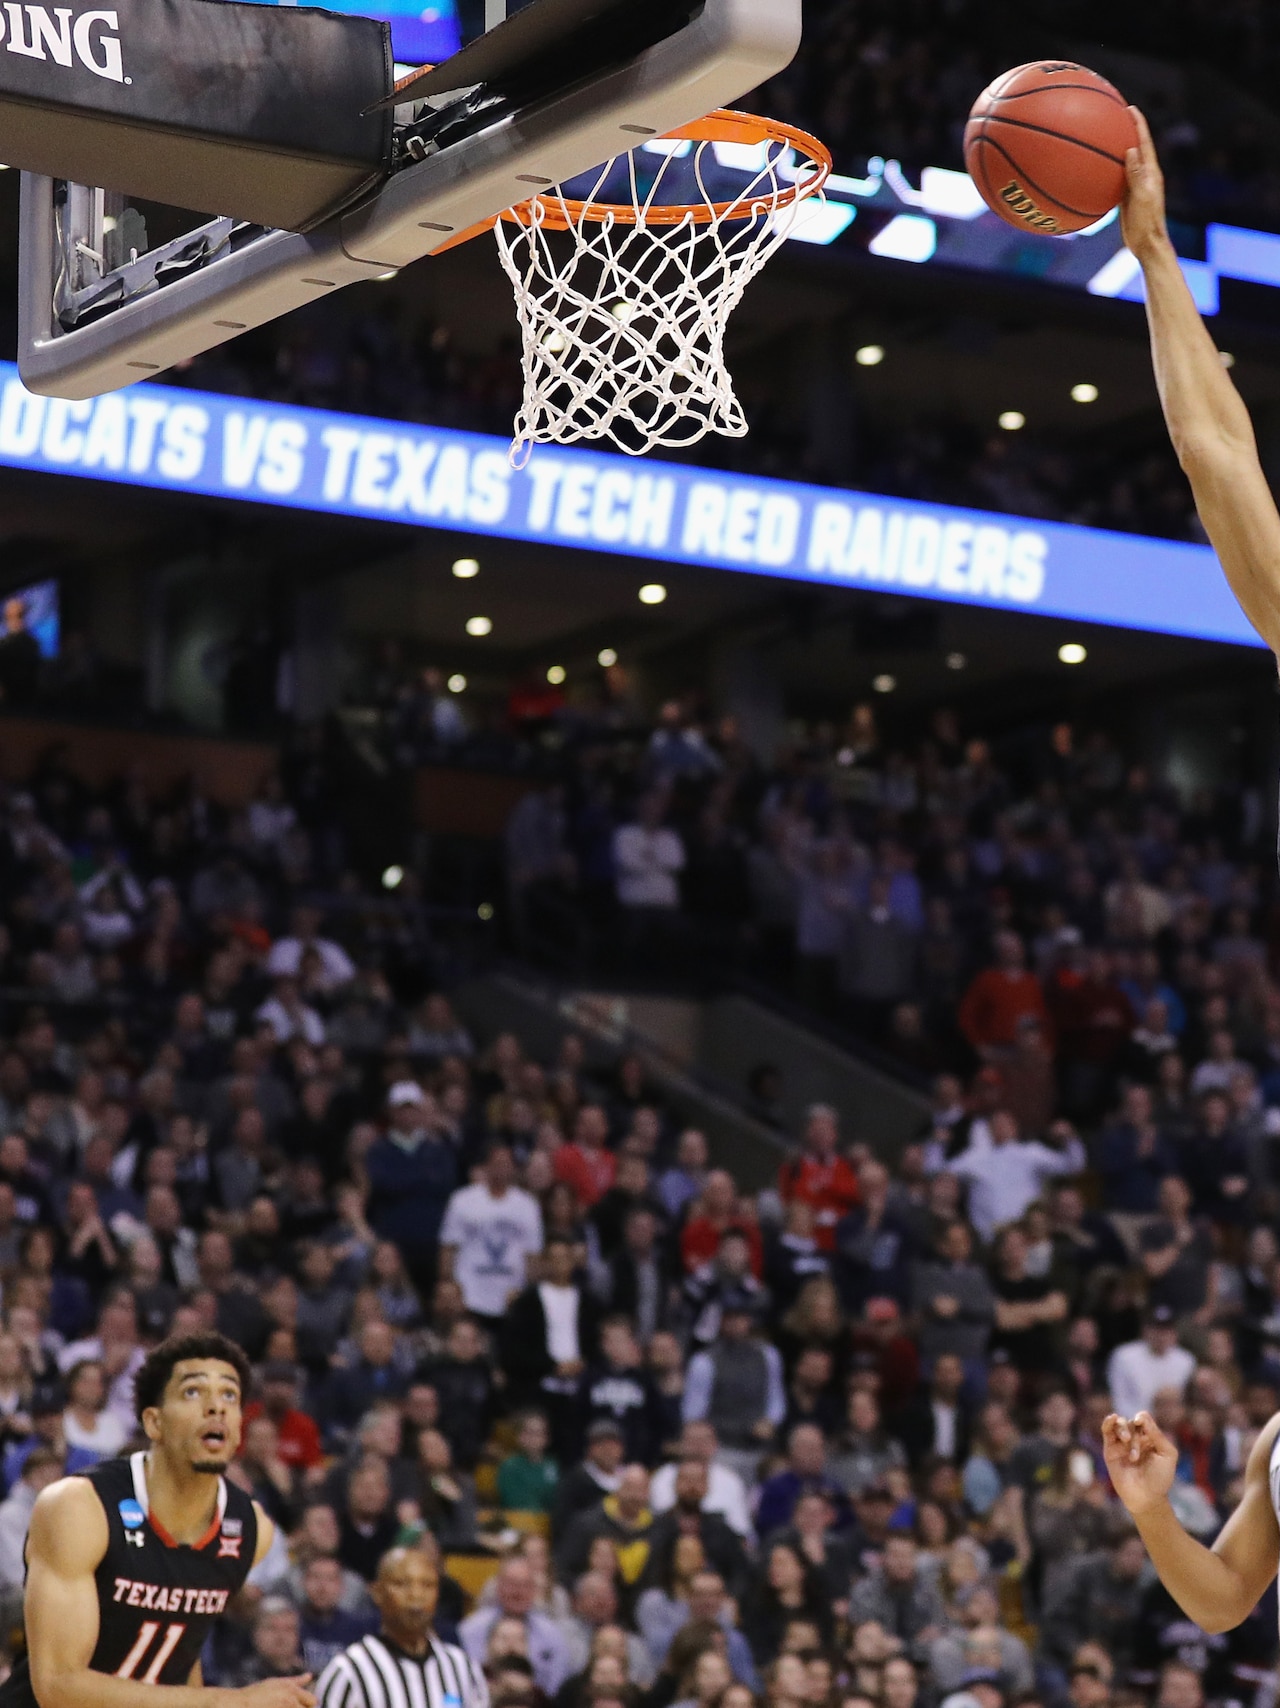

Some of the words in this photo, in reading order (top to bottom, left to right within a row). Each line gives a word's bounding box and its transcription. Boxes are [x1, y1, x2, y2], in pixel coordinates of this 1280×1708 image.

[0, 2, 124, 83] ING
[222, 413, 306, 495] VS
[321, 429, 512, 524] TEXAS
[527, 459, 675, 547] TECH
[682, 484, 801, 566] RED
[806, 502, 1047, 602] RAIDERS
[113, 1577, 184, 1613] TEXAS
[183, 1588, 229, 1615] TECH
[114, 1621, 187, 1685] 11
